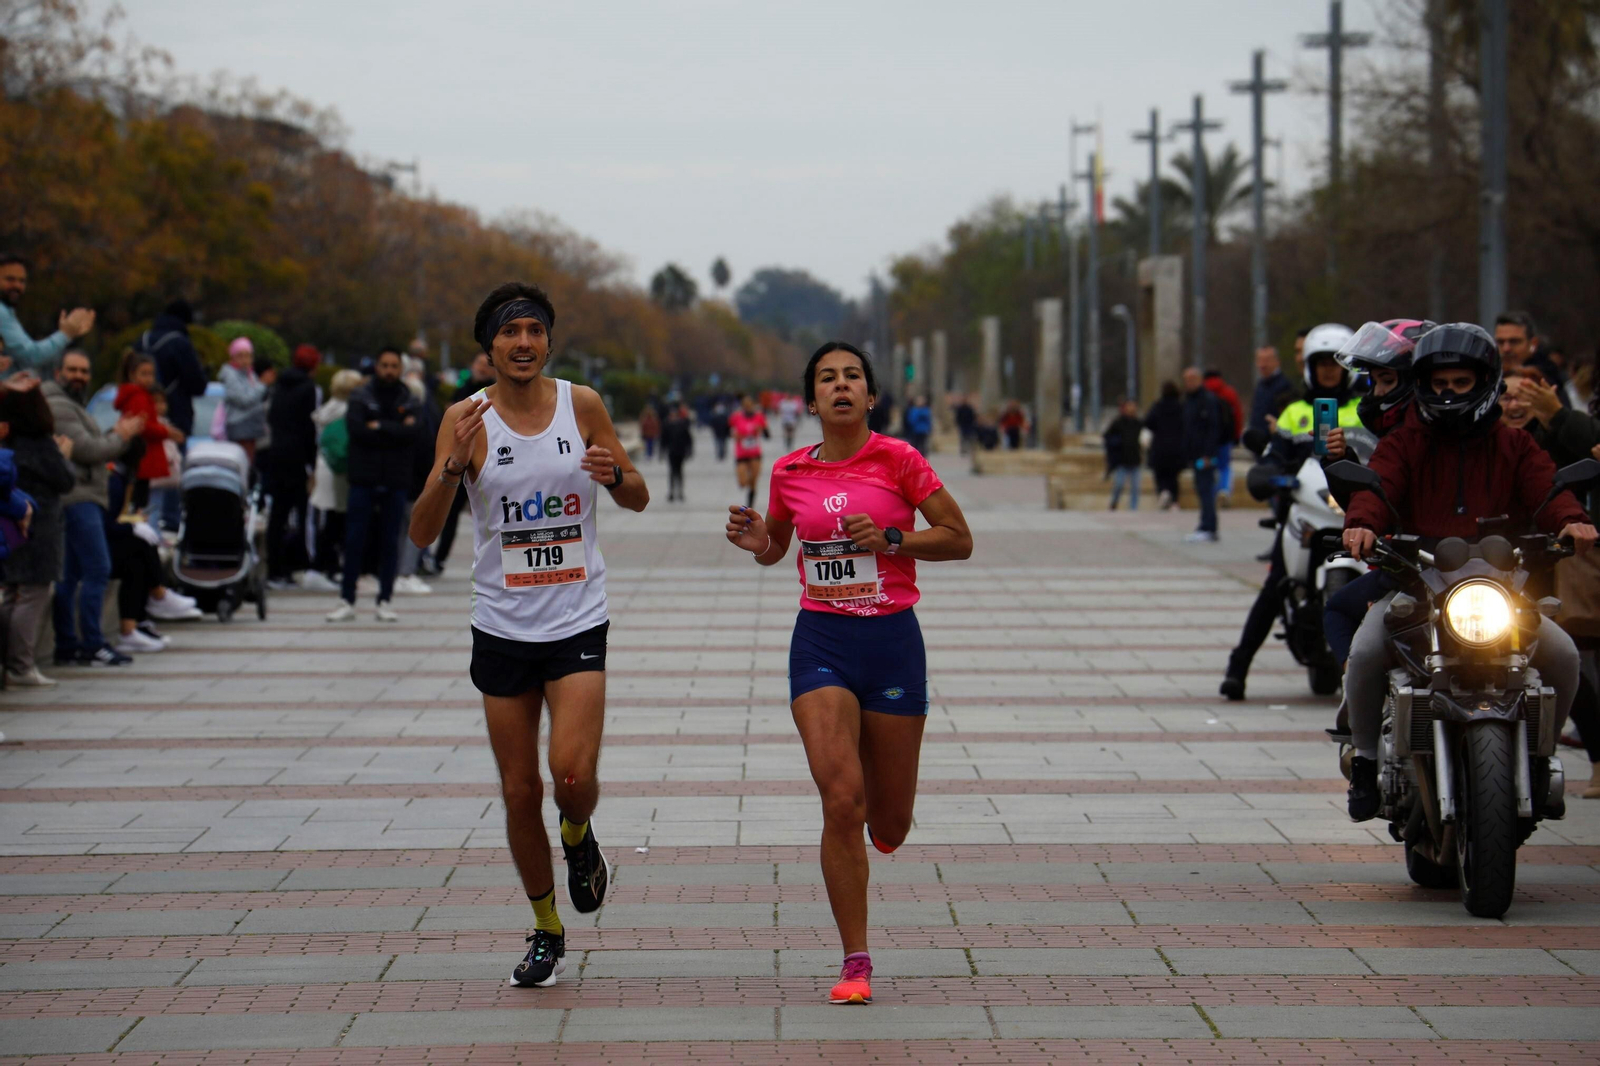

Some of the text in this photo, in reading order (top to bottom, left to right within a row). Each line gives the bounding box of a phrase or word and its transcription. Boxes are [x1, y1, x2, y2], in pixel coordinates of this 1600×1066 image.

[556, 436, 571, 455] in
[500, 491, 581, 523] indea
[523, 545, 564, 568] 1719
[814, 558, 856, 581] 1704
